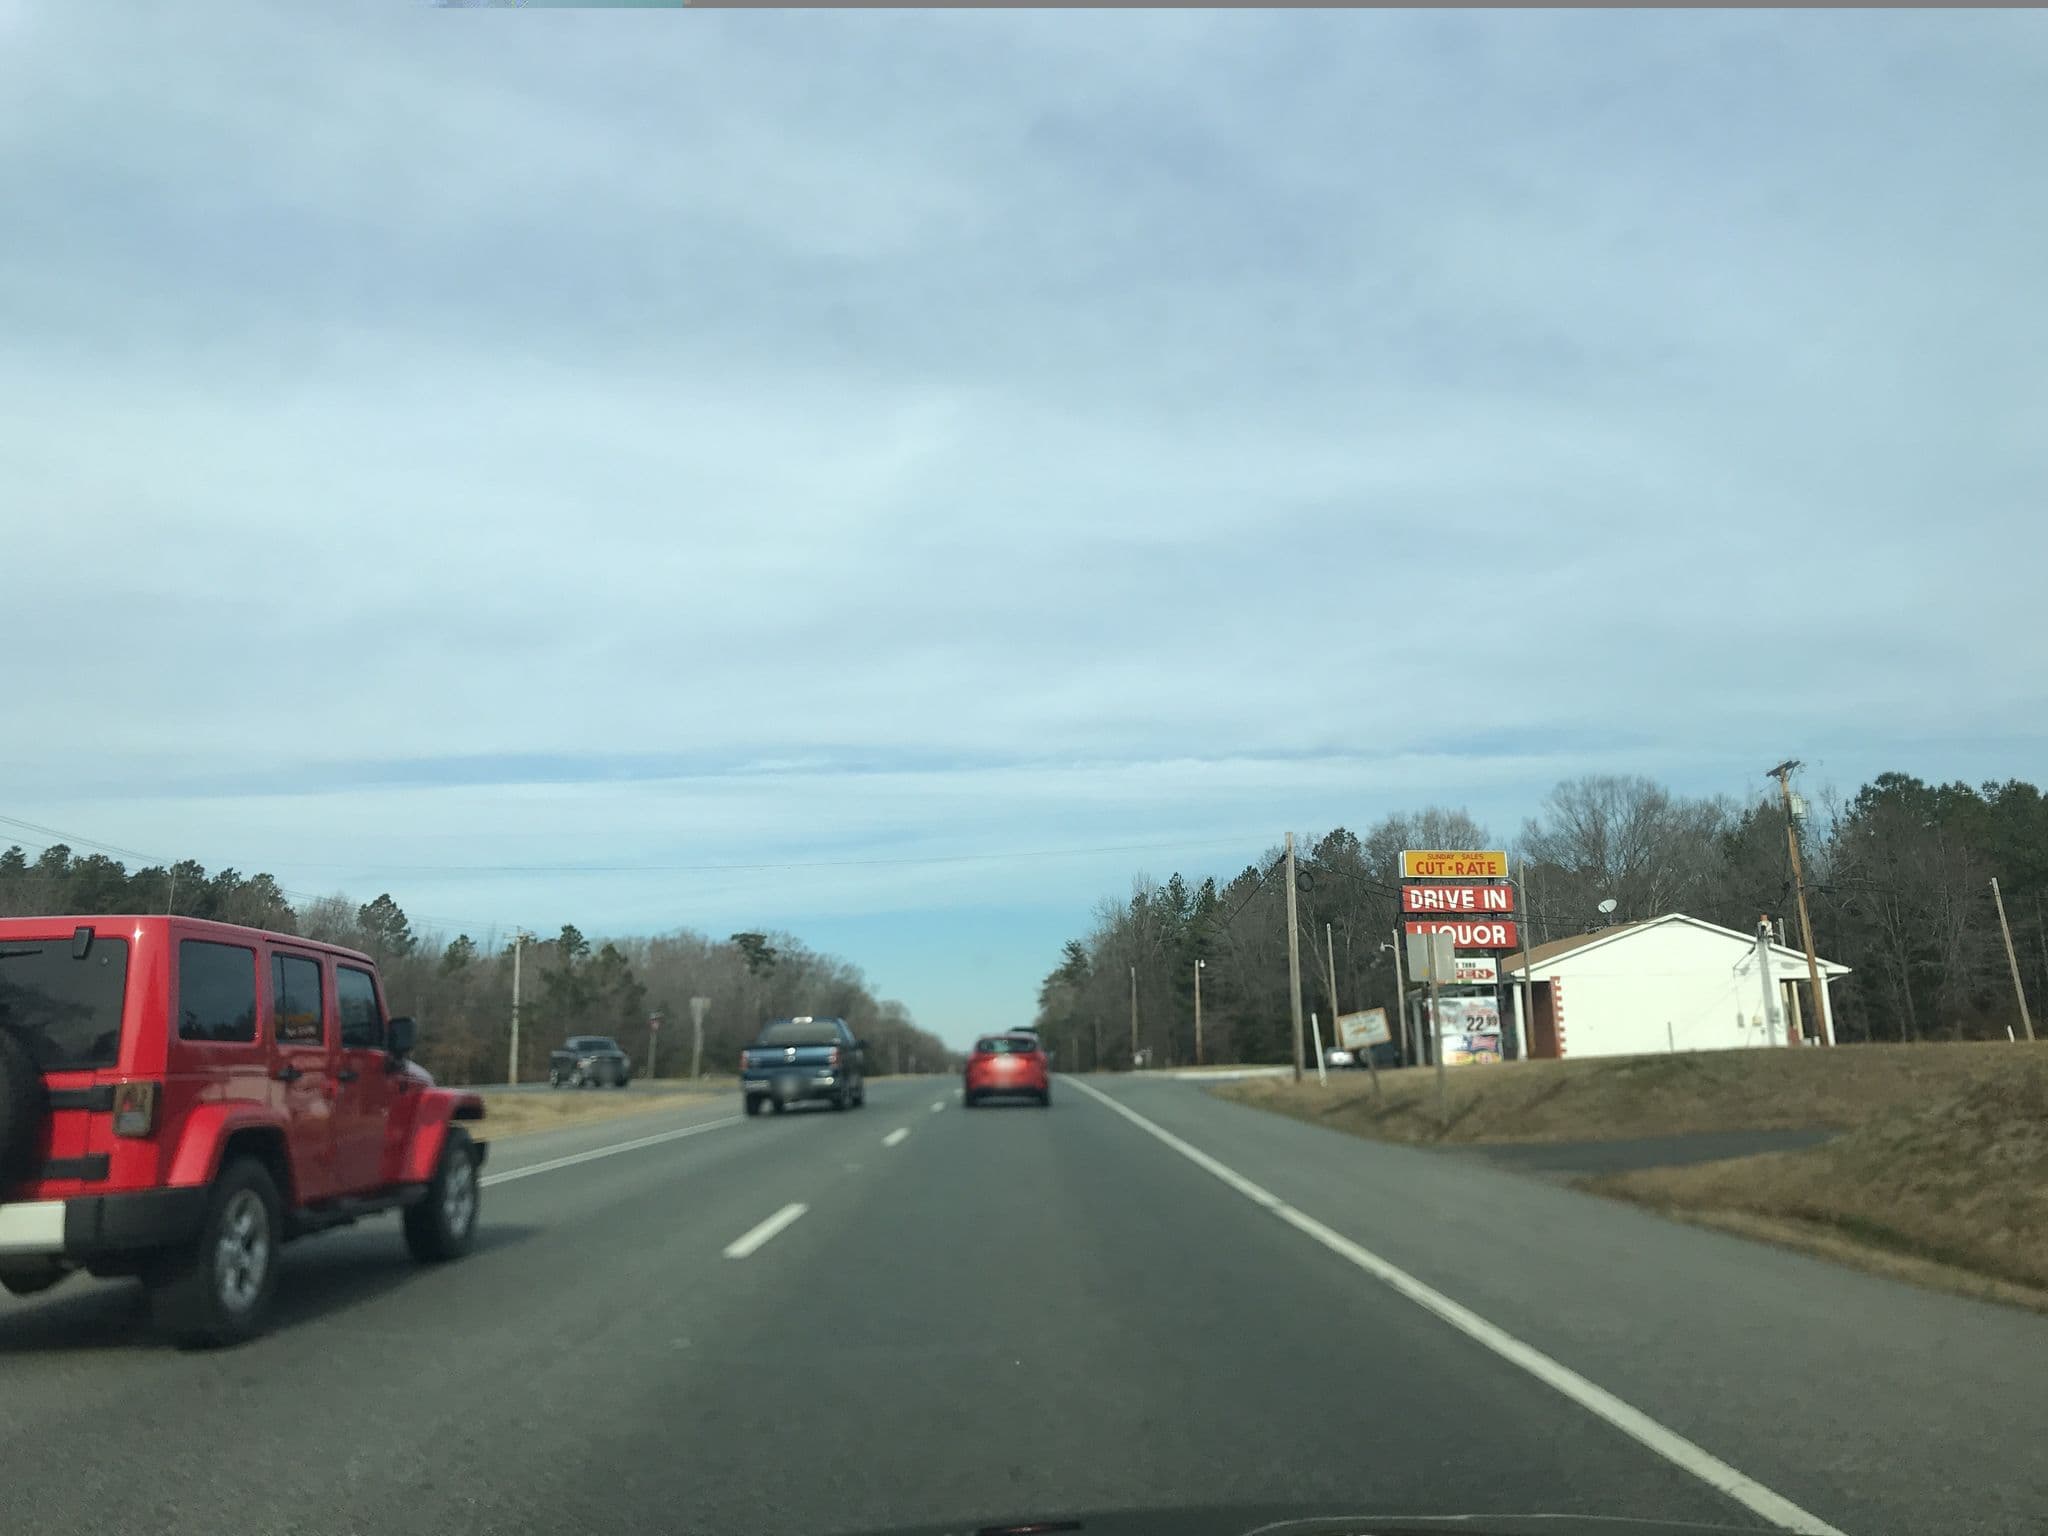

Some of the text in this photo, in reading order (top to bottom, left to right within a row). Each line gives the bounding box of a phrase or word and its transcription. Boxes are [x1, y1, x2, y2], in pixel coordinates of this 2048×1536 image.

[1410, 889, 1507, 909] DRIVE IN
[1456, 969, 1487, 979] PEN
